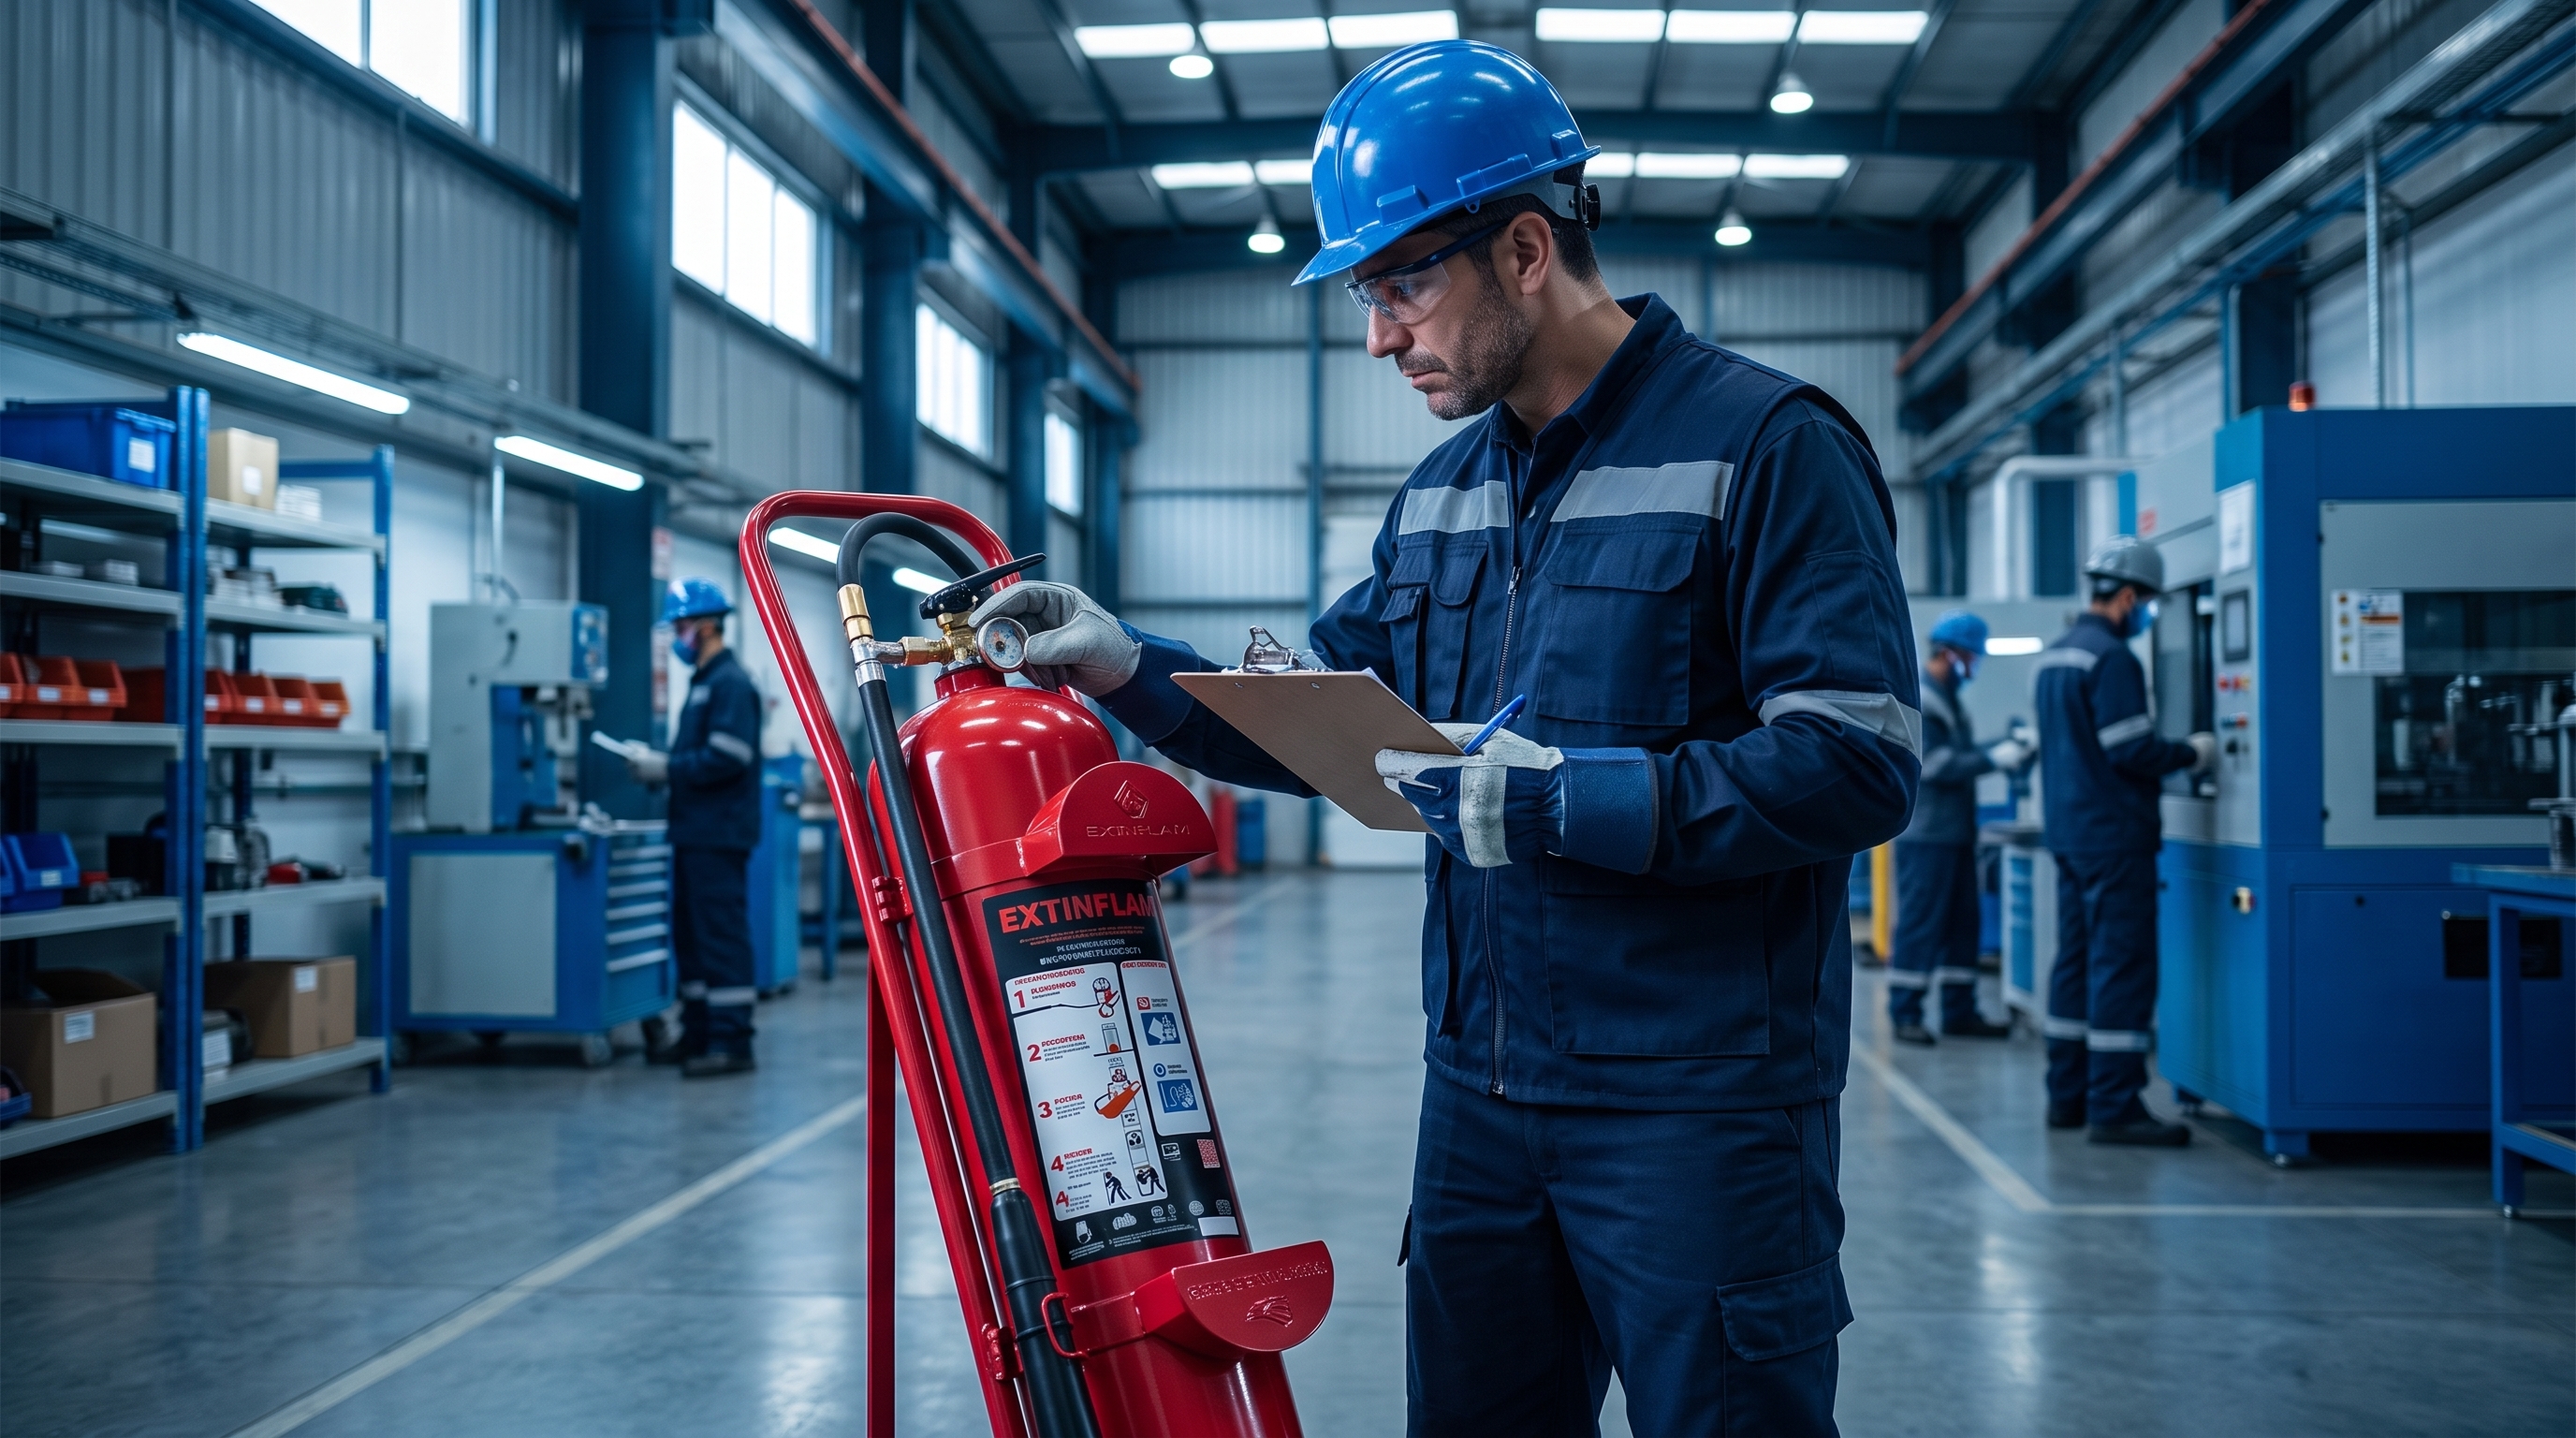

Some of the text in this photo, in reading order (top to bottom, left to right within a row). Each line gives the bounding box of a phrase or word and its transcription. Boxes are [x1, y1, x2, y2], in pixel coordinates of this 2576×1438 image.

[998, 892, 1156, 933] EXTINFLAM
[1014, 990, 1026, 1009] 1
[1027, 1044, 1042, 1062] 2
[1037, 1101, 1053, 1119] 3
[1050, 1155, 1064, 1172] 4
[1055, 1190, 1070, 1208] 4
